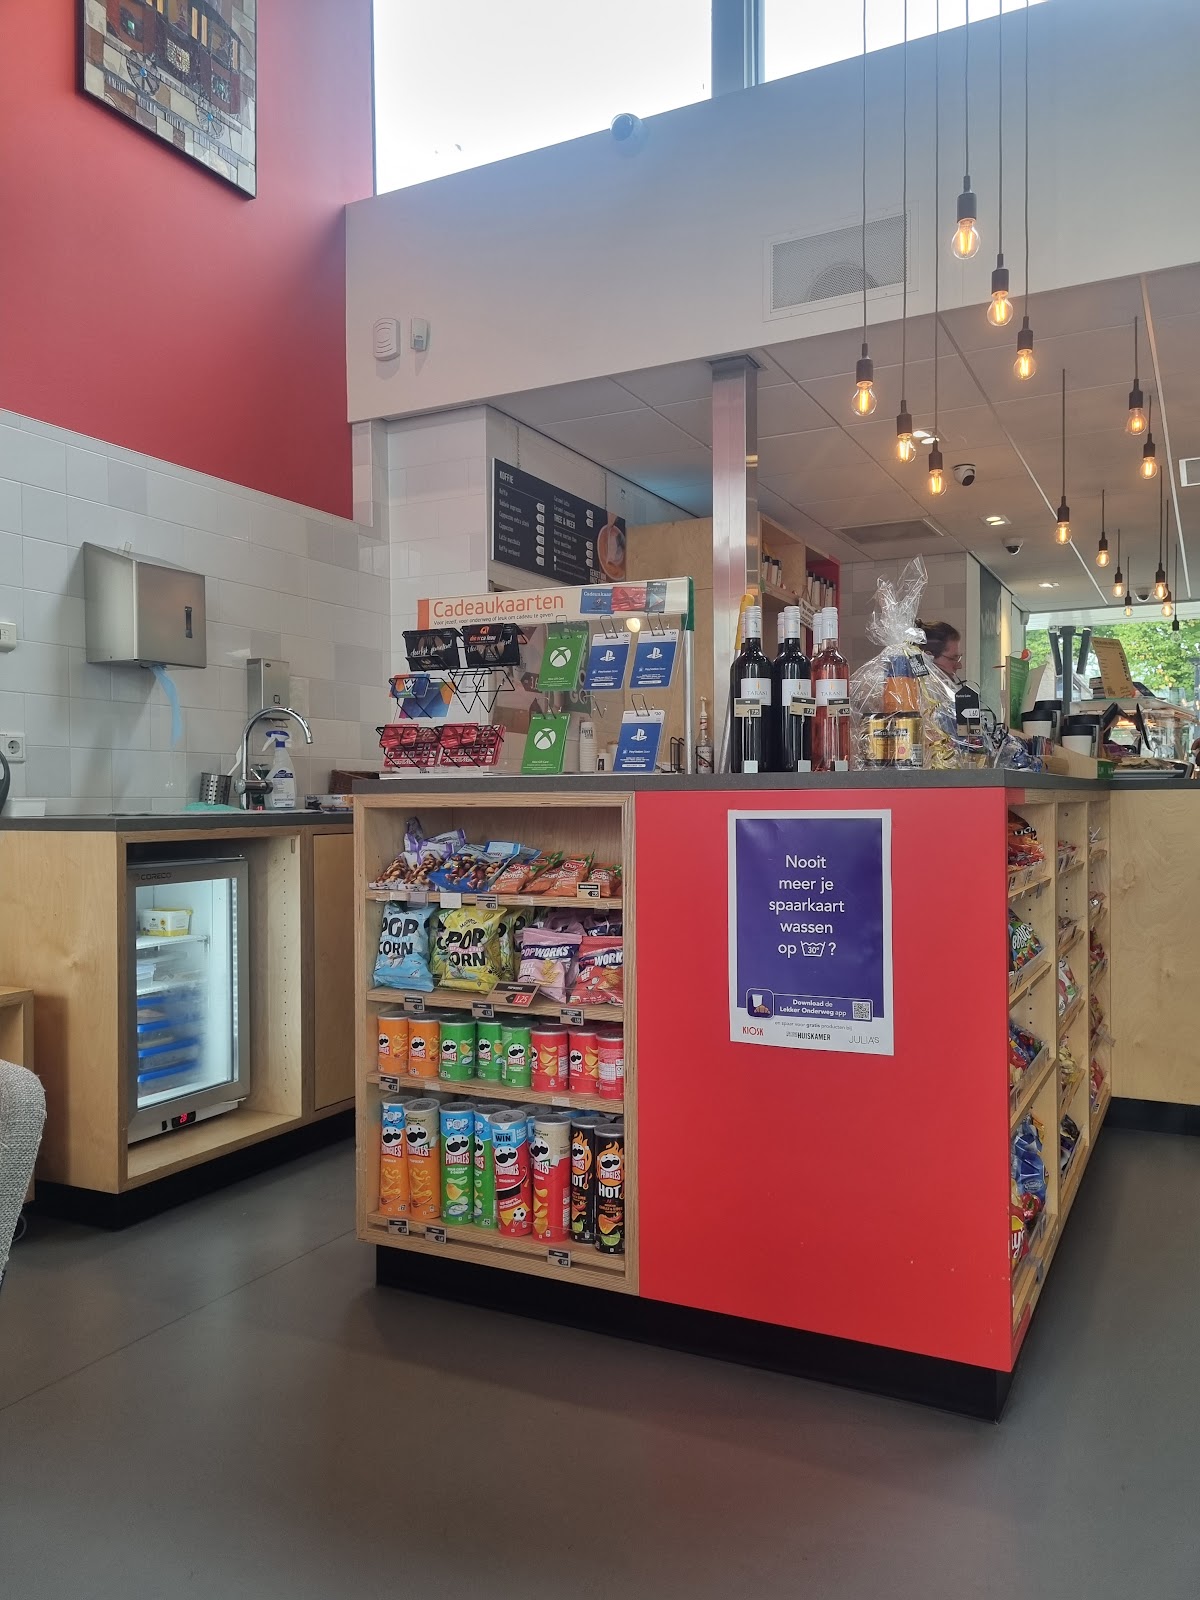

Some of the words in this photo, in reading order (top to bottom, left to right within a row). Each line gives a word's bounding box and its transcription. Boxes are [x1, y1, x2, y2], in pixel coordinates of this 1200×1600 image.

[500, 470, 514, 484] KOFFIE
[433, 594, 564, 618] Cadeaukaarten
[785, 854, 826, 868] Nooit
[778, 878, 816, 890] meer
[820, 877, 834, 894] je
[768, 898, 844, 915] spaarkaart
[381, 917, 420, 938] POP
[780, 922, 833, 934] wassen
[447, 928, 486, 949] POP
[521, 946, 570, 957] POPWORKS
[778, 943, 797, 958] op
[828, 942, 837, 956] ?
[793, 999, 824, 1007] Download
[801, 1007, 834, 1016] Onderweg
[742, 1026, 764, 1036] KIOSK
[798, 1032, 831, 1040] HUISKAMER
[848, 1035, 880, 1044] JULIA'S
[445, 1152, 470, 1164] PRINGLES
[601, 1169, 621, 1180] PRINGLES
[599, 1182, 621, 1198] HOT
